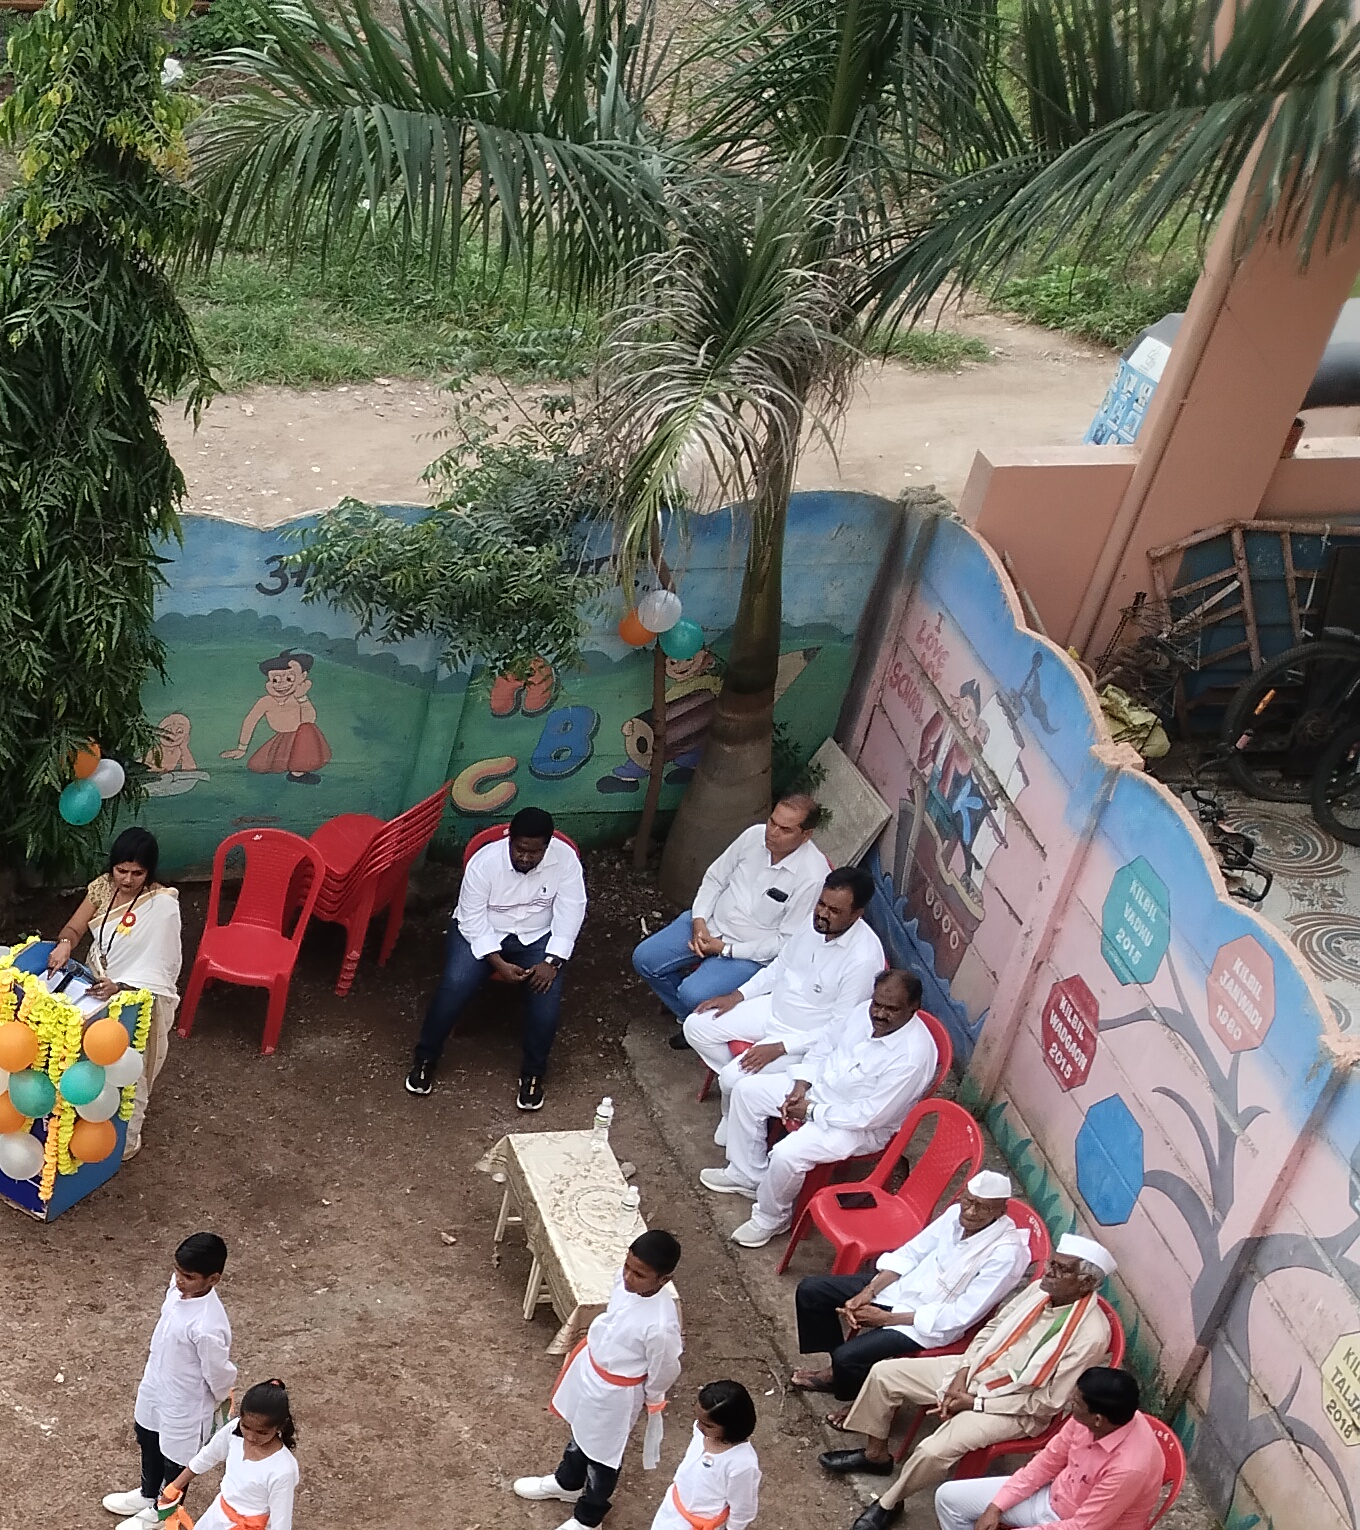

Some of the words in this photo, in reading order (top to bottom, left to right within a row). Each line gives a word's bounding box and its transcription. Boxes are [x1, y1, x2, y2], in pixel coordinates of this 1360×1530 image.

[530, 705, 600, 780] B
[451, 756, 518, 815] C
[1129, 879, 1157, 922] KILBIL
[1123, 902, 1154, 947] VADHU
[1219, 969, 1263, 1030] JANWADI
[1232, 957, 1263, 1001] KILBIL
[1049, 1009, 1087, 1072] WADGAON
[1059, 996, 1084, 1041] KILBIL
[1343, 1347, 1360, 1384] KIL
